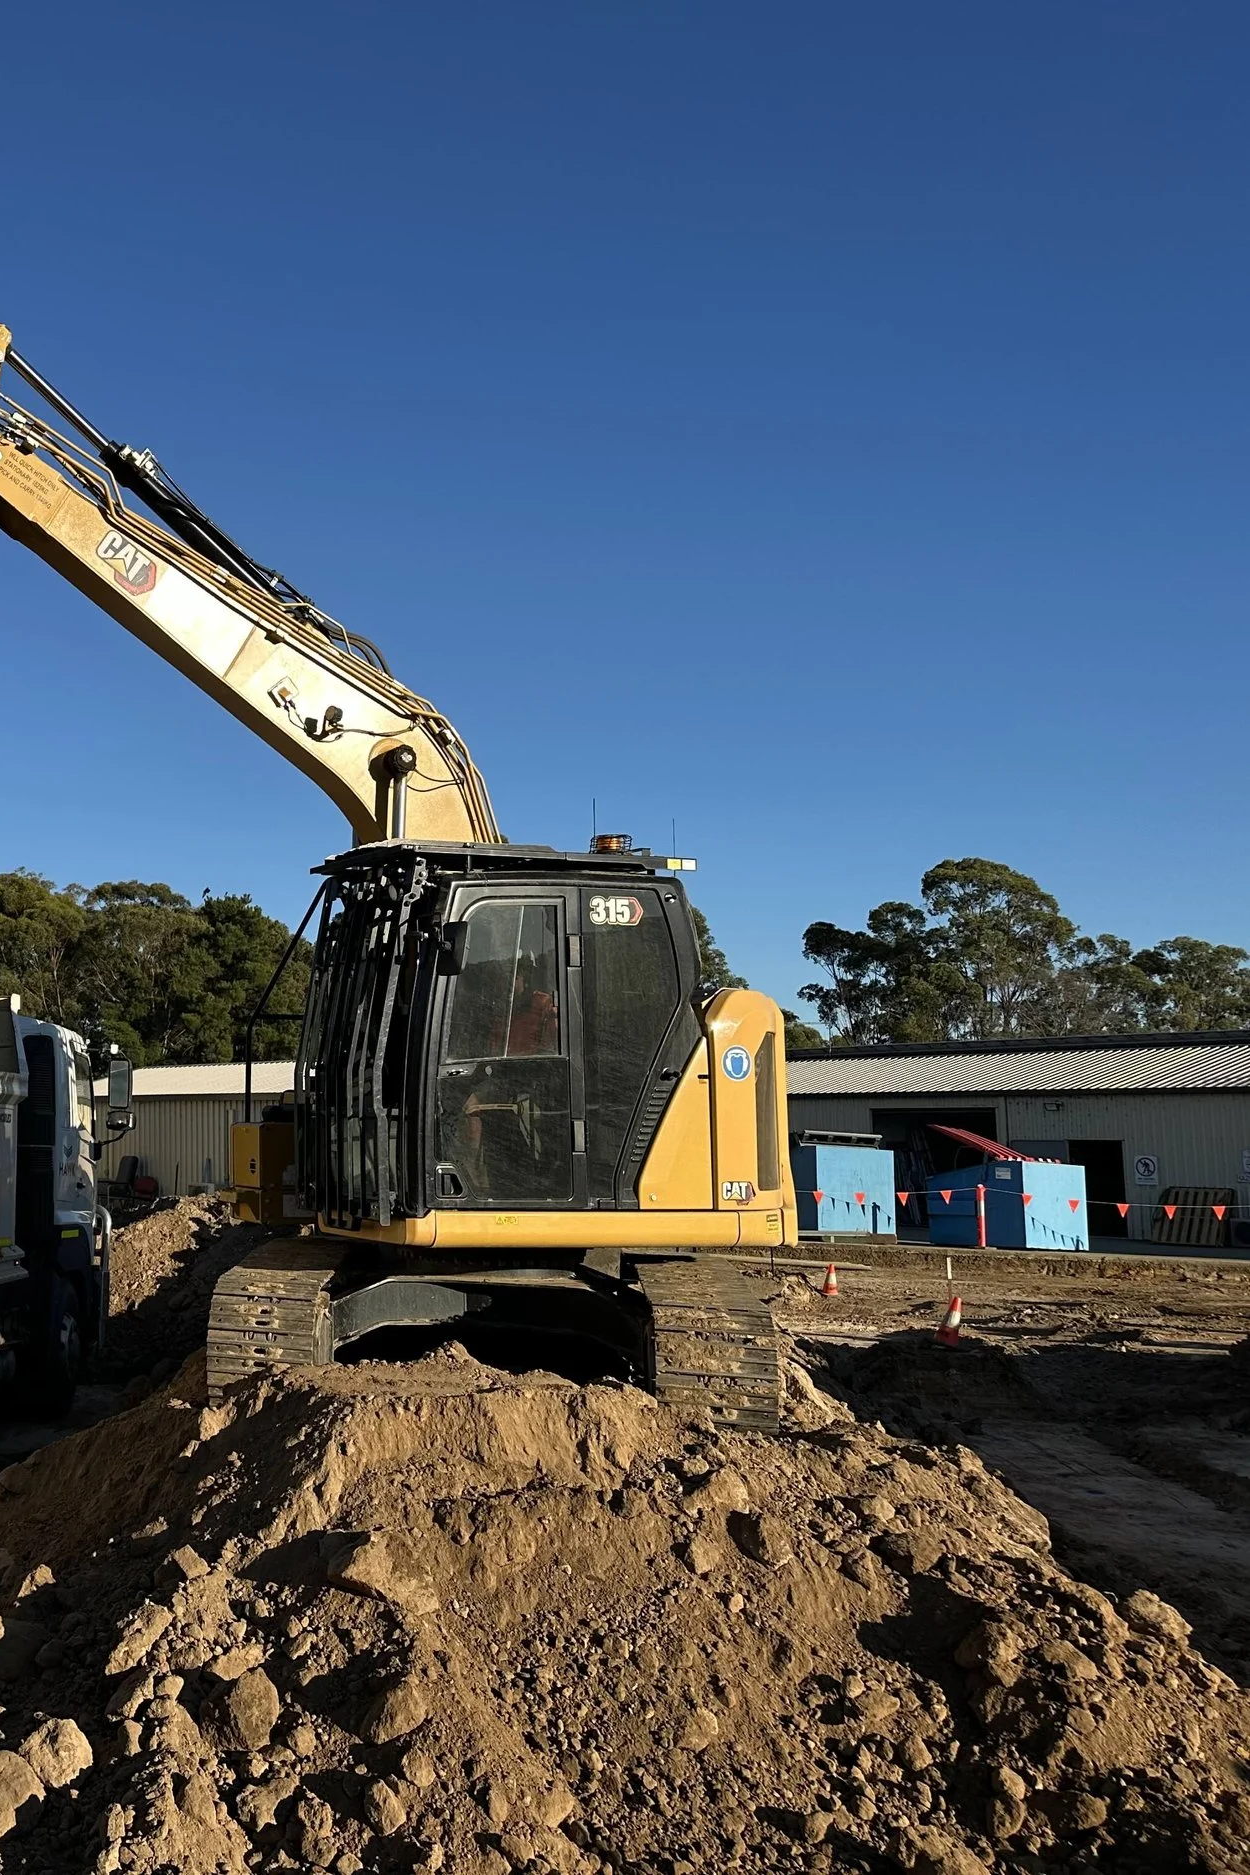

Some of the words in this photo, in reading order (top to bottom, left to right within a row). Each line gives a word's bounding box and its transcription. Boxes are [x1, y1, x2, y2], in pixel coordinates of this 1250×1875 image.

[4, 459, 32, 482] STATIONARY
[19, 459, 33, 473] QUICK
[33, 470, 47, 483] HITCH
[47, 482, 60, 492] ONLY
[9, 476, 20, 486] AND
[19, 482, 35, 496] CARRY
[96, 530, 152, 582] CAT
[590, 896, 631, 924] 315
[722, 1181, 748, 1200] CAT
